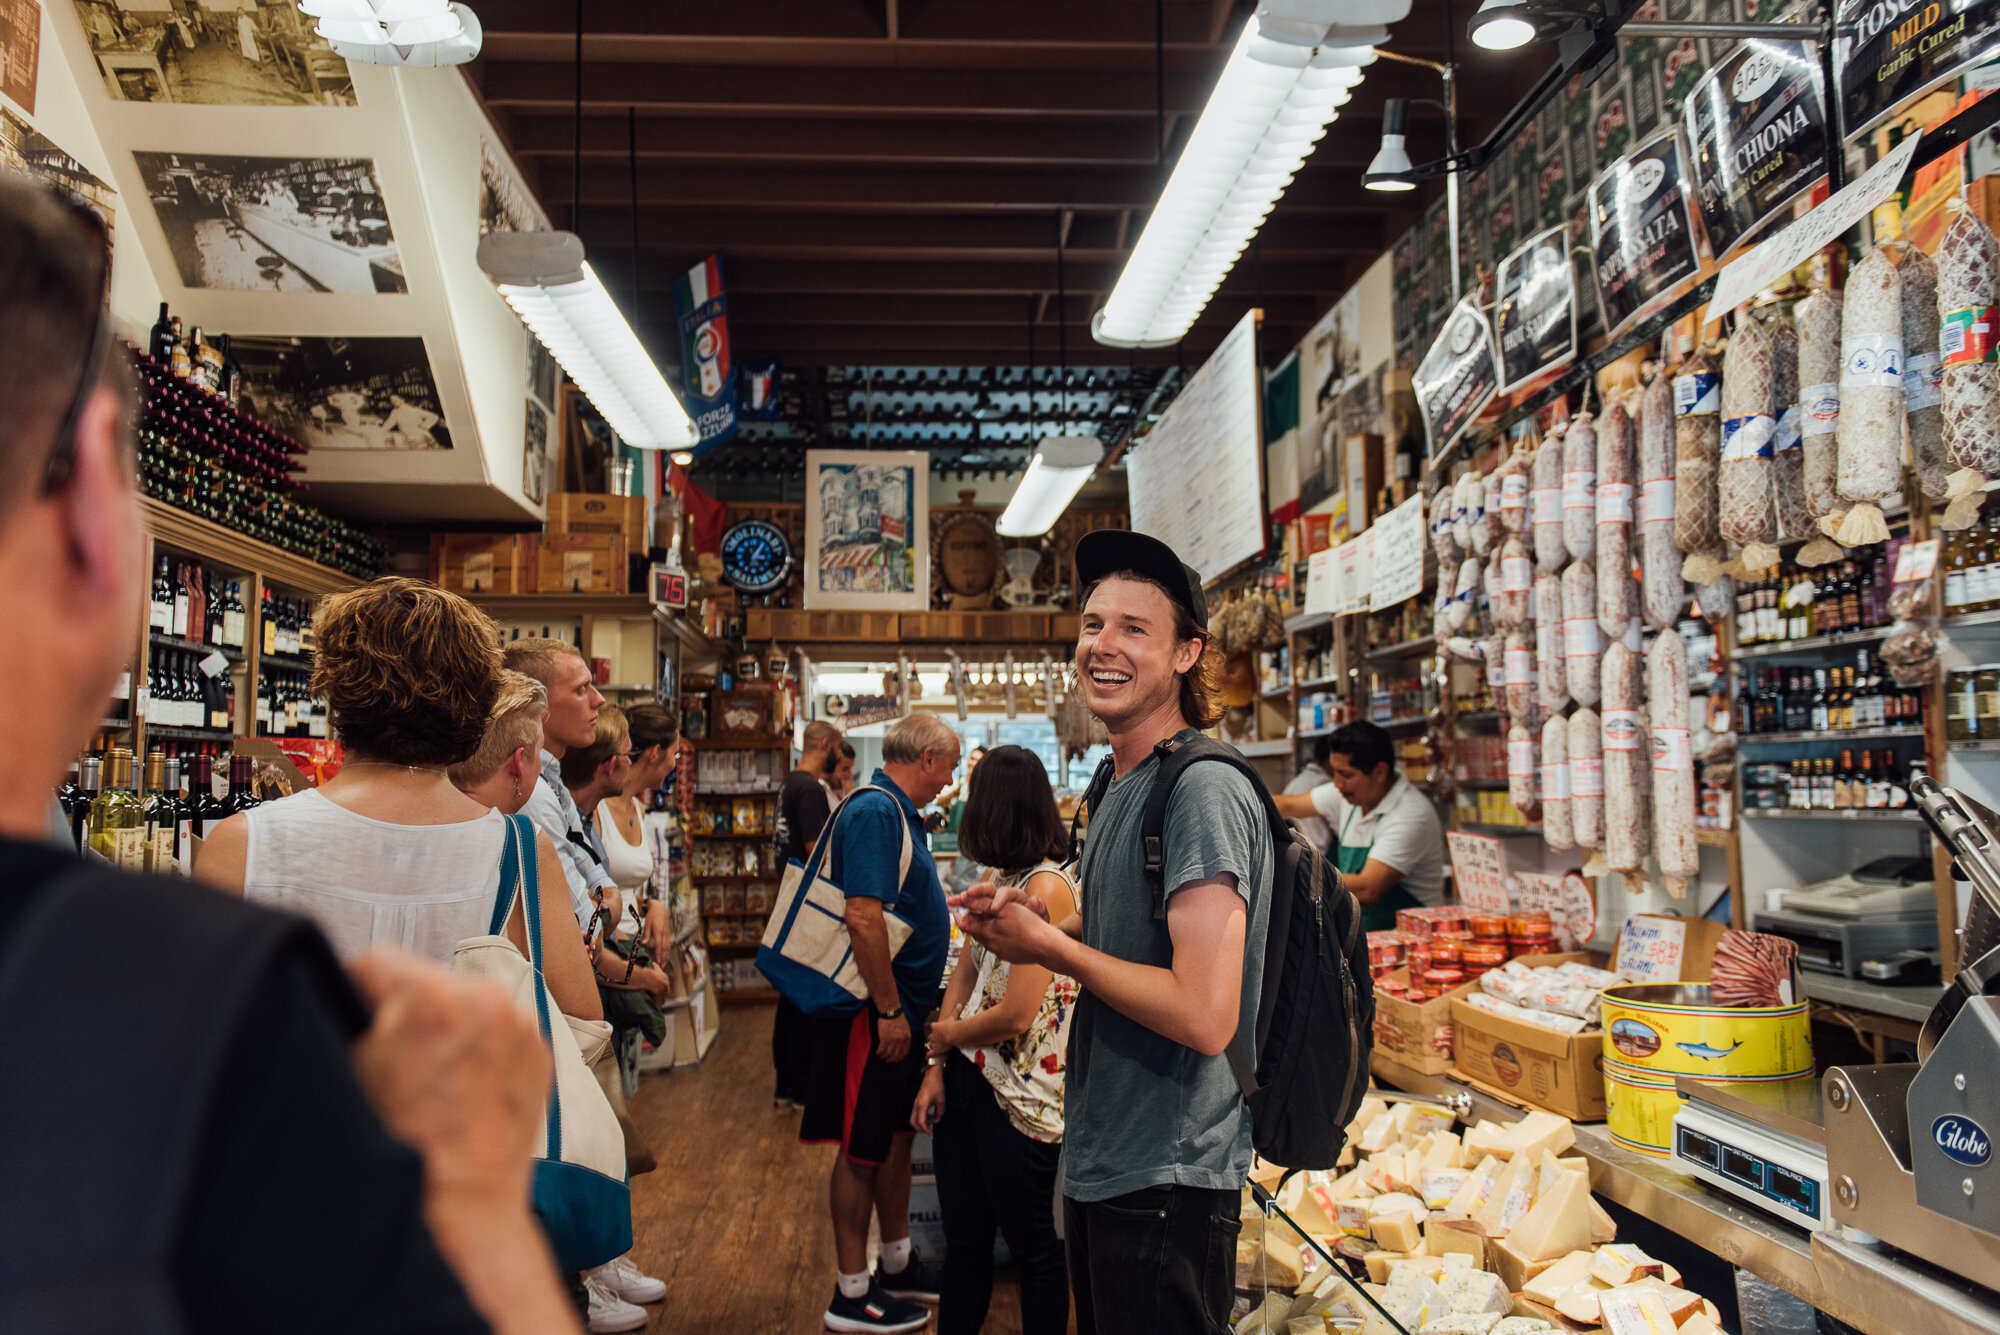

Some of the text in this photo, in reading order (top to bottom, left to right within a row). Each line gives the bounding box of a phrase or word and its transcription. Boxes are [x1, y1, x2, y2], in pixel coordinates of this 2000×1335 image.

[1891, 2, 1940, 51] MILD
[1877, 46, 1917, 82] Garlic
[1918, 13, 1965, 55] Cured
[1751, 151, 1784, 185] Cured
[725, 526, 783, 557] MOLINARI
[731, 566, 775, 585] SALAME
[1935, 1119, 1989, 1157] Globe
[1741, 1152, 1754, 1162] PRICE
[1777, 1166, 1804, 1183] TOTAL PRICE
